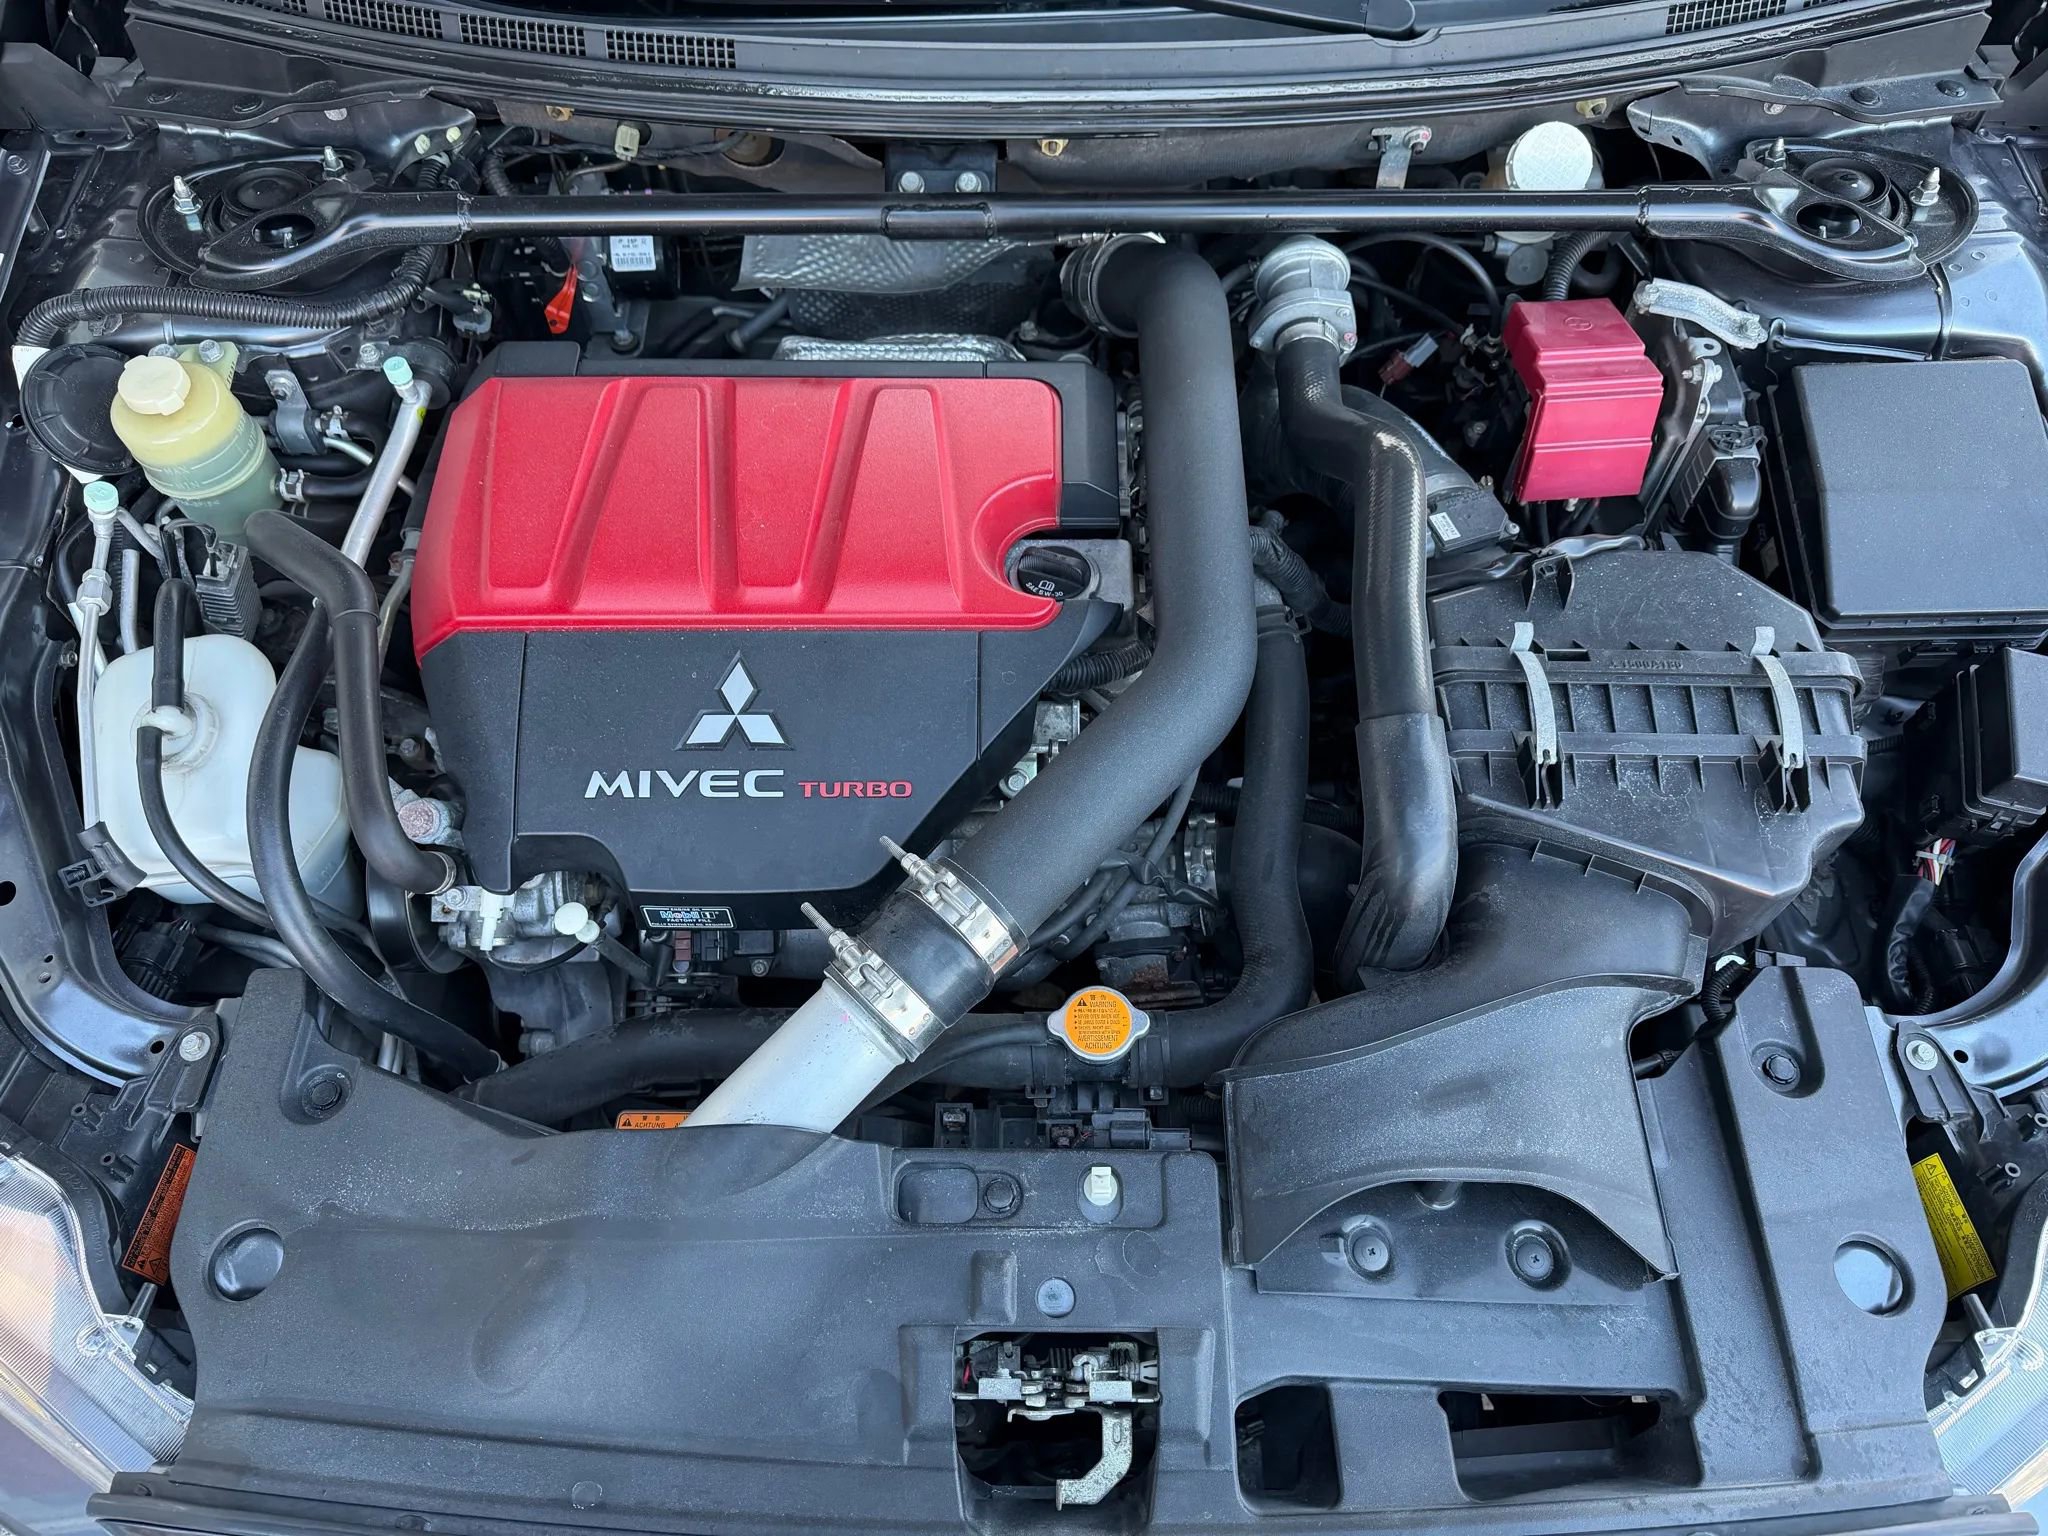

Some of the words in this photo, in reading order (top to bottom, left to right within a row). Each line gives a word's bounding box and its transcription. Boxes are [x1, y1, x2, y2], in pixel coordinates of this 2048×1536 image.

[1025, 581, 1039, 593] SAE
[584, 769, 785, 799] MIVEC
[797, 781, 913, 798] TURBO
[660, 911, 700, 919] Mobil
